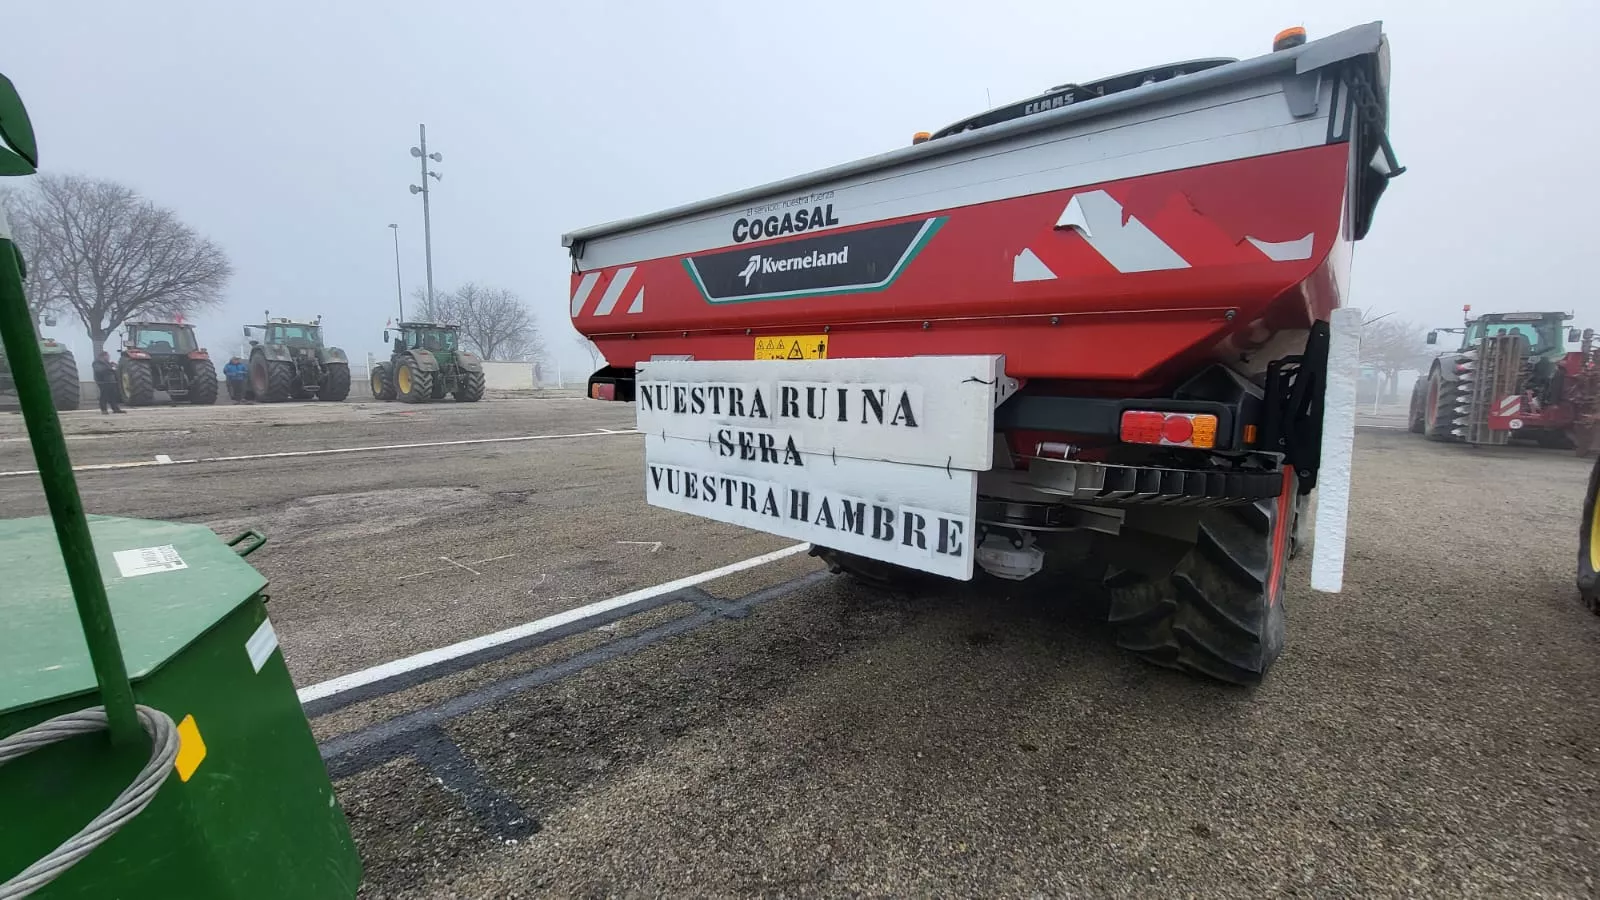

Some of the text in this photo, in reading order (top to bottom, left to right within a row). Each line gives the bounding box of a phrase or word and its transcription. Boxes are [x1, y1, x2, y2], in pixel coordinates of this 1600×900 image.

[733, 204, 839, 242] COGASAL
[762, 246, 848, 273] Kverneland
[640, 384, 919, 428] NUESTRA RUINA
[717, 428, 804, 467] SERA
[650, 466, 964, 557] VUESTRA HAMBRE
